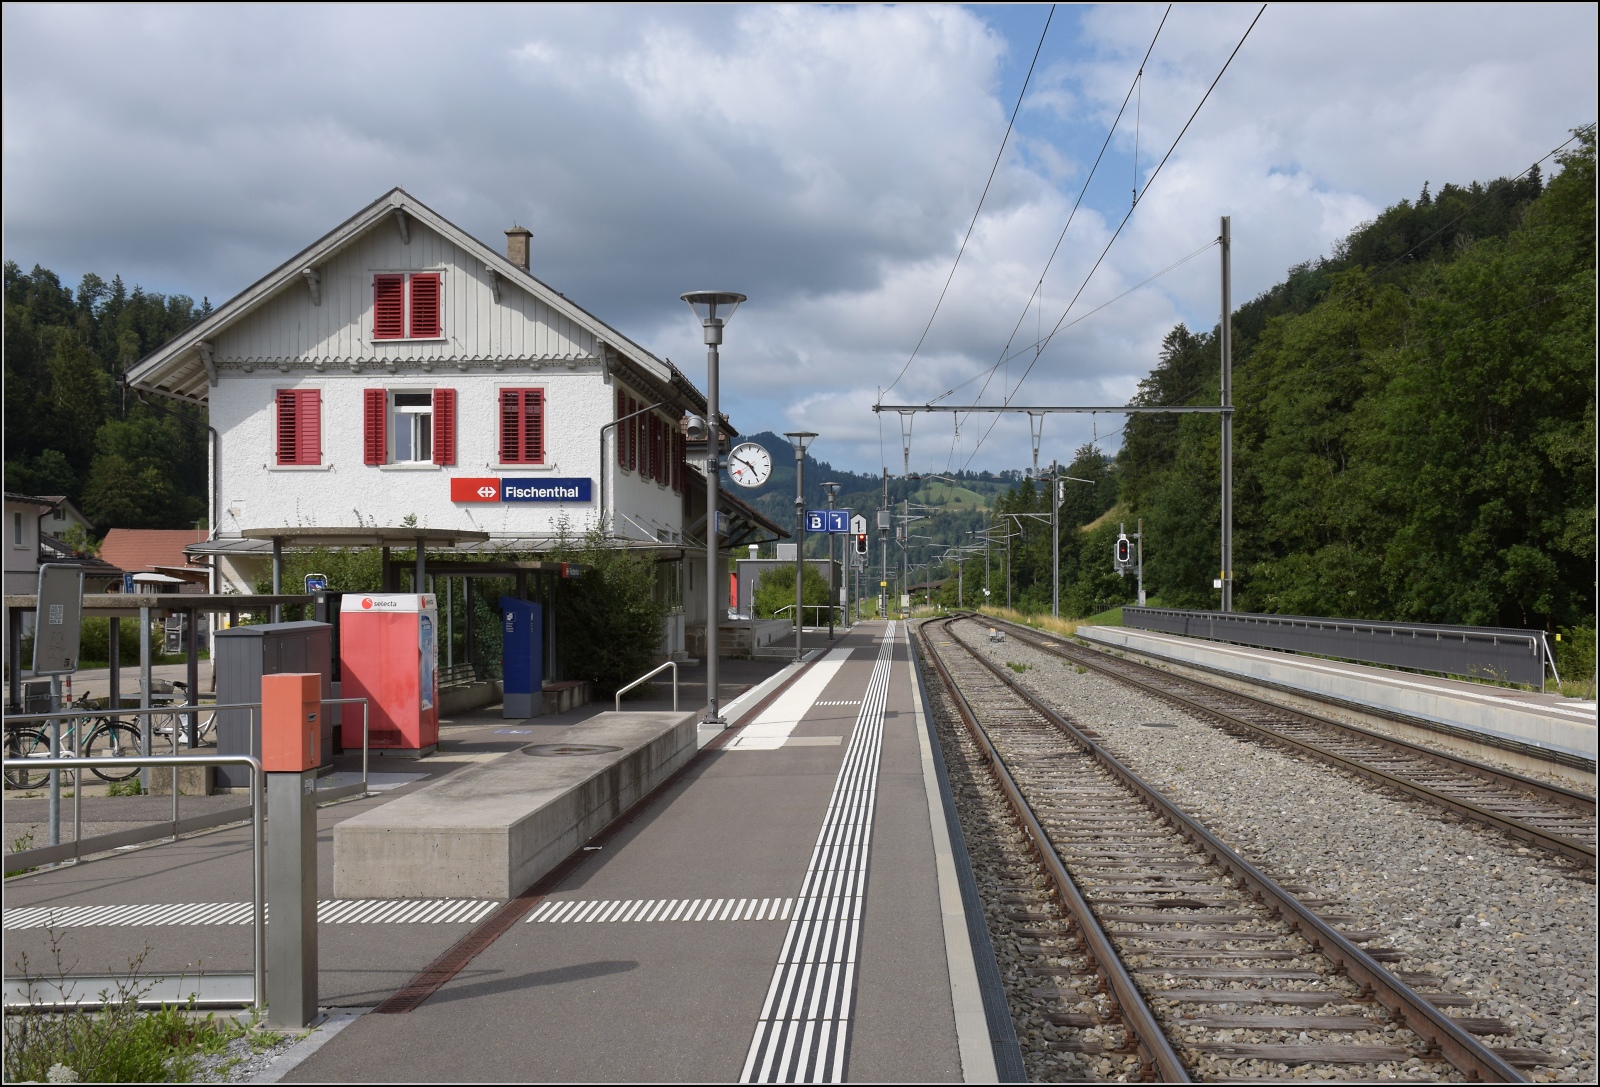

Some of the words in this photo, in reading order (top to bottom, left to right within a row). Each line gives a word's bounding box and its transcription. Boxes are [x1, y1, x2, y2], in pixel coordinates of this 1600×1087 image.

[505, 486, 579, 498] Fischenthal
[812, 517, 822, 528] B
[836, 517, 842, 528] 1
[854, 520, 860, 532] 1
[126, 576, 132, 588] P
